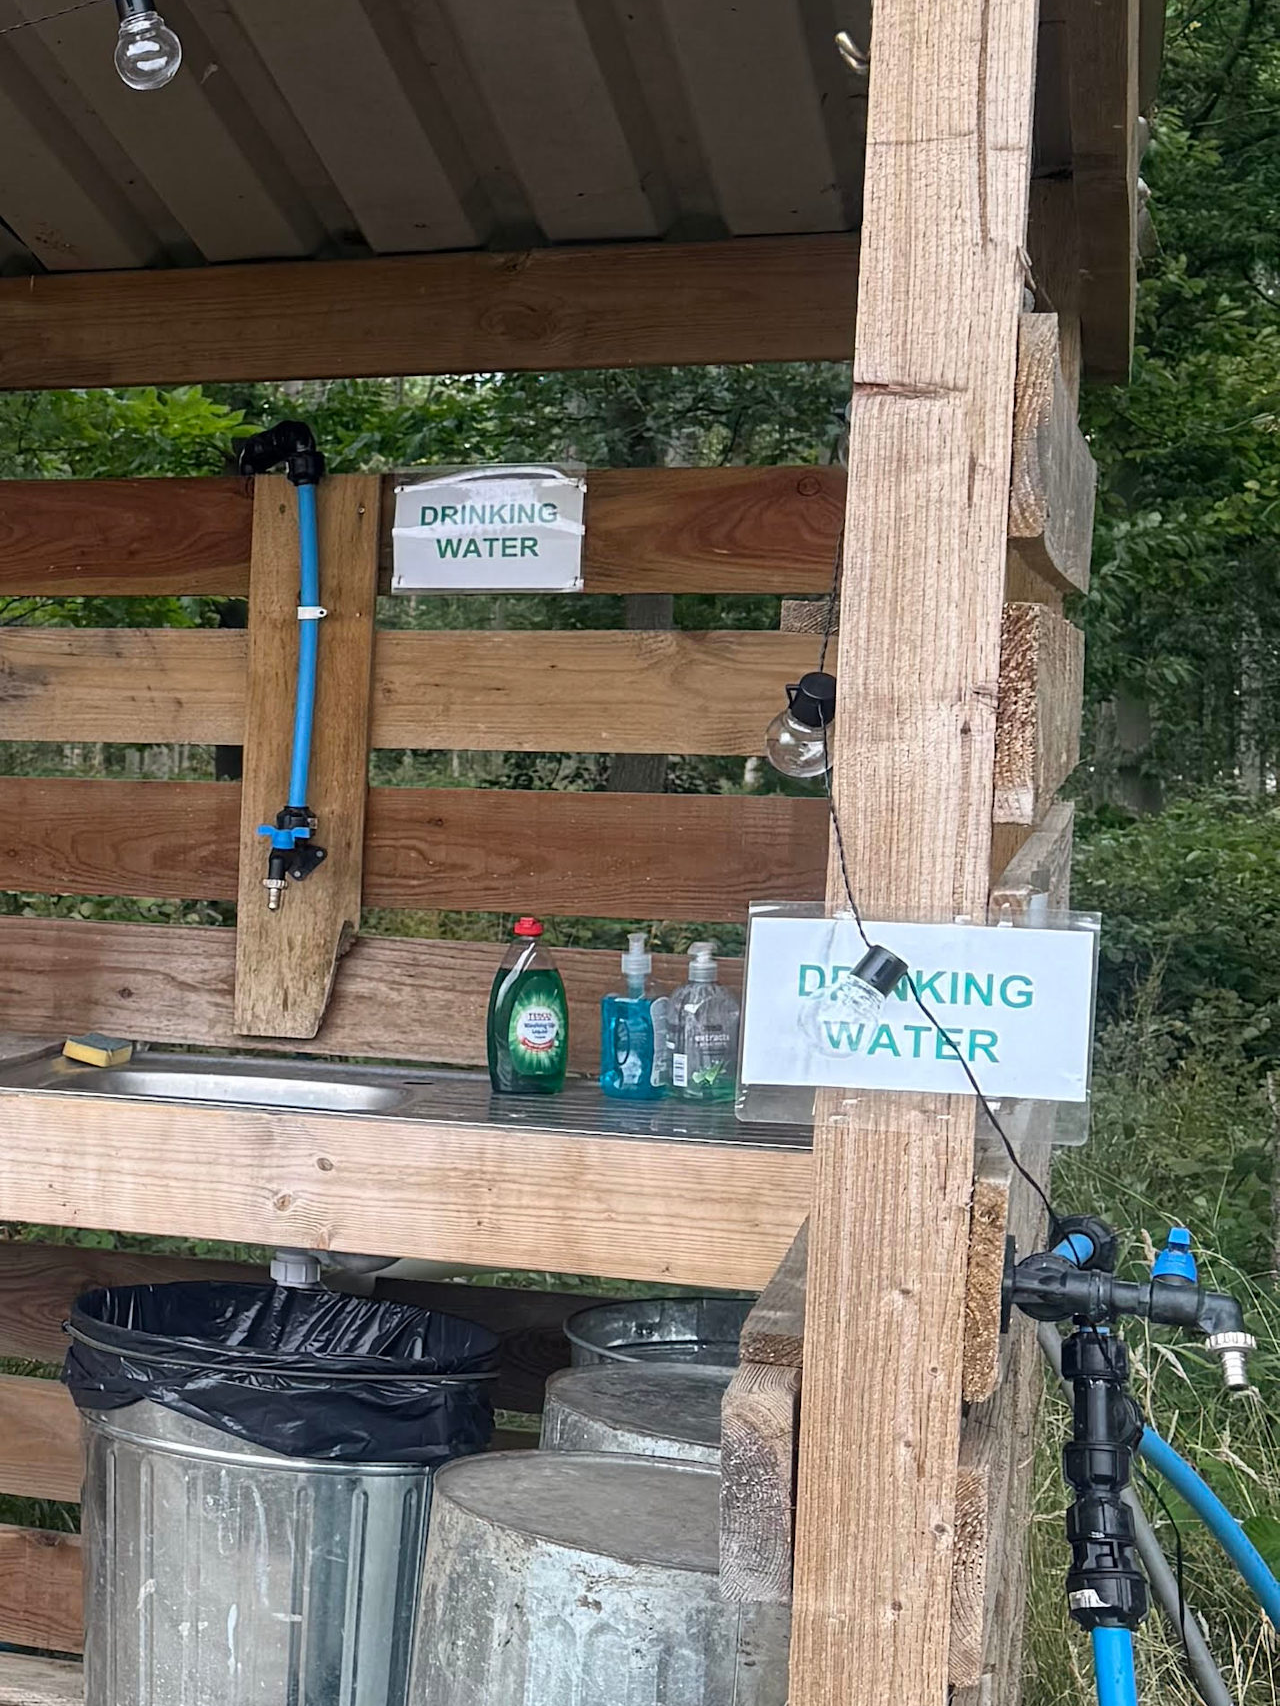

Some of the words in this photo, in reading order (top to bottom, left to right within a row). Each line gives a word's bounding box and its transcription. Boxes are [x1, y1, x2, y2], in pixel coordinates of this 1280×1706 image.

[420, 502, 558, 526] DRINKING
[436, 537, 540, 559] WATER
[797, 963, 1034, 1009] DNKING
[694, 1033, 730, 1042] extracts
[823, 1020, 1000, 1064] WATER
